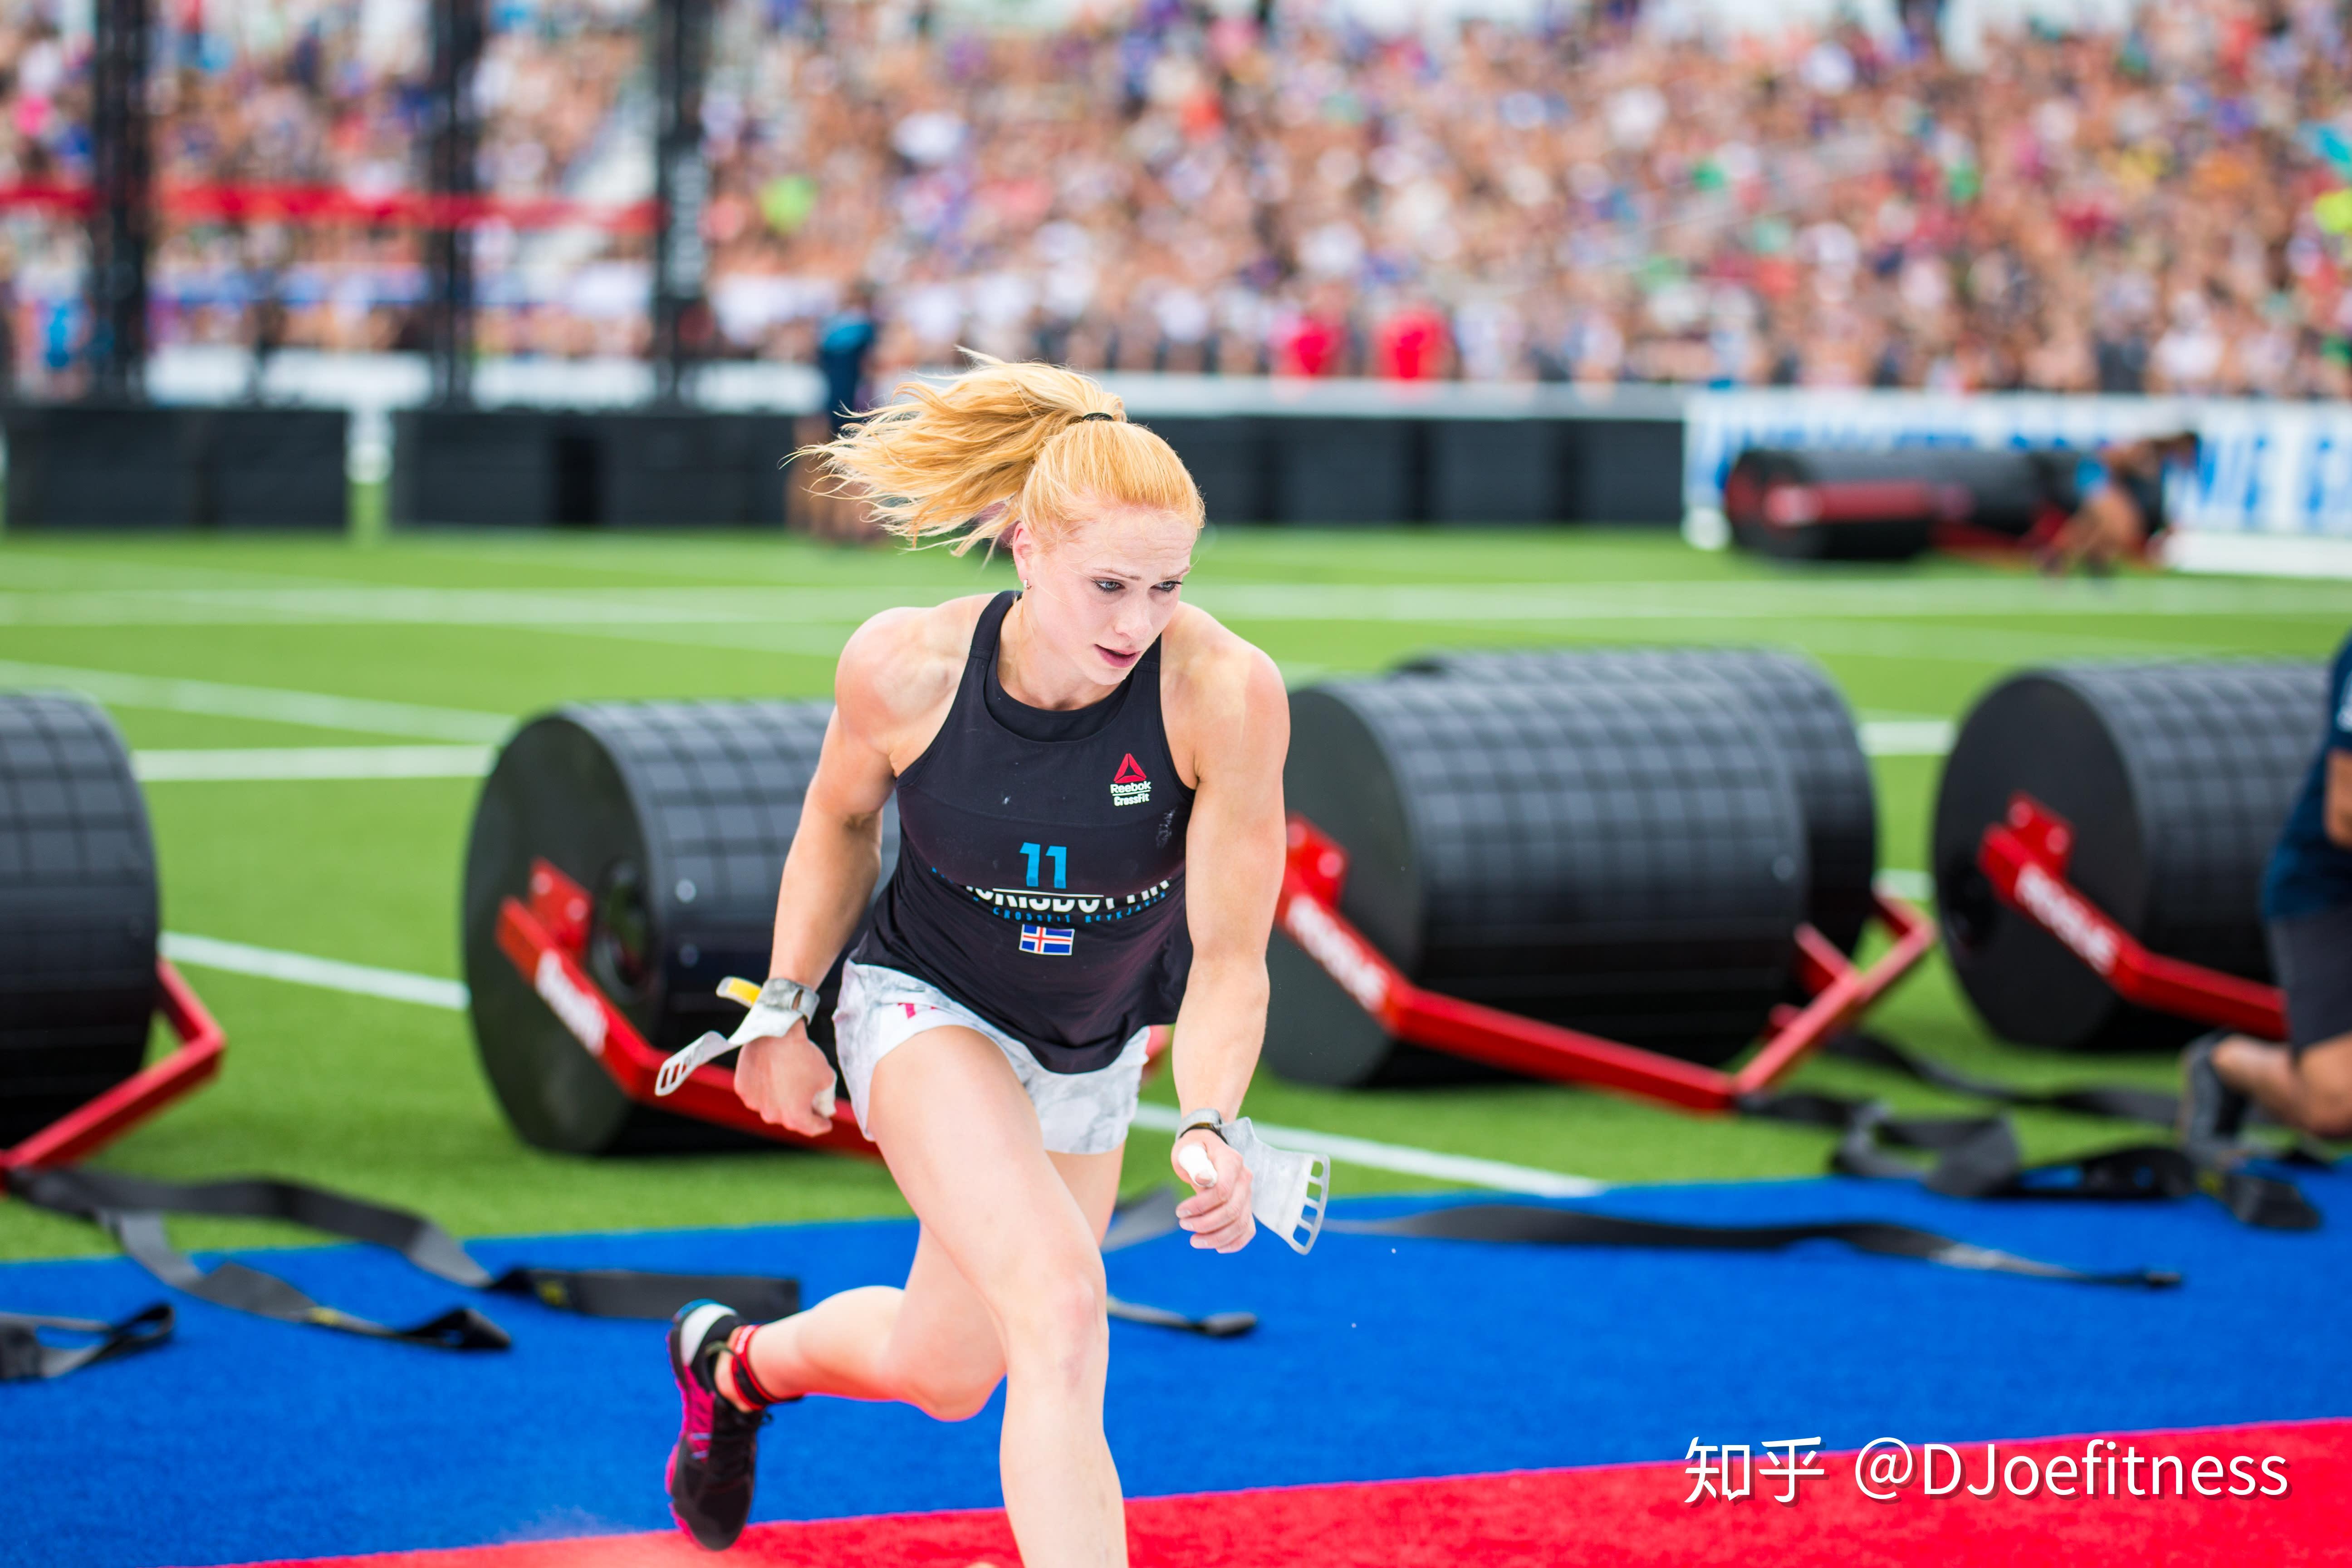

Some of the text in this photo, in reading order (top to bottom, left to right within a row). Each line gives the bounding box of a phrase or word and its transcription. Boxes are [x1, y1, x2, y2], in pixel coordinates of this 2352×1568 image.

[1110, 780, 1152, 794] Reebok
[1114, 793, 1150, 806] CrossFit
[1019, 842, 1068, 889] 11
